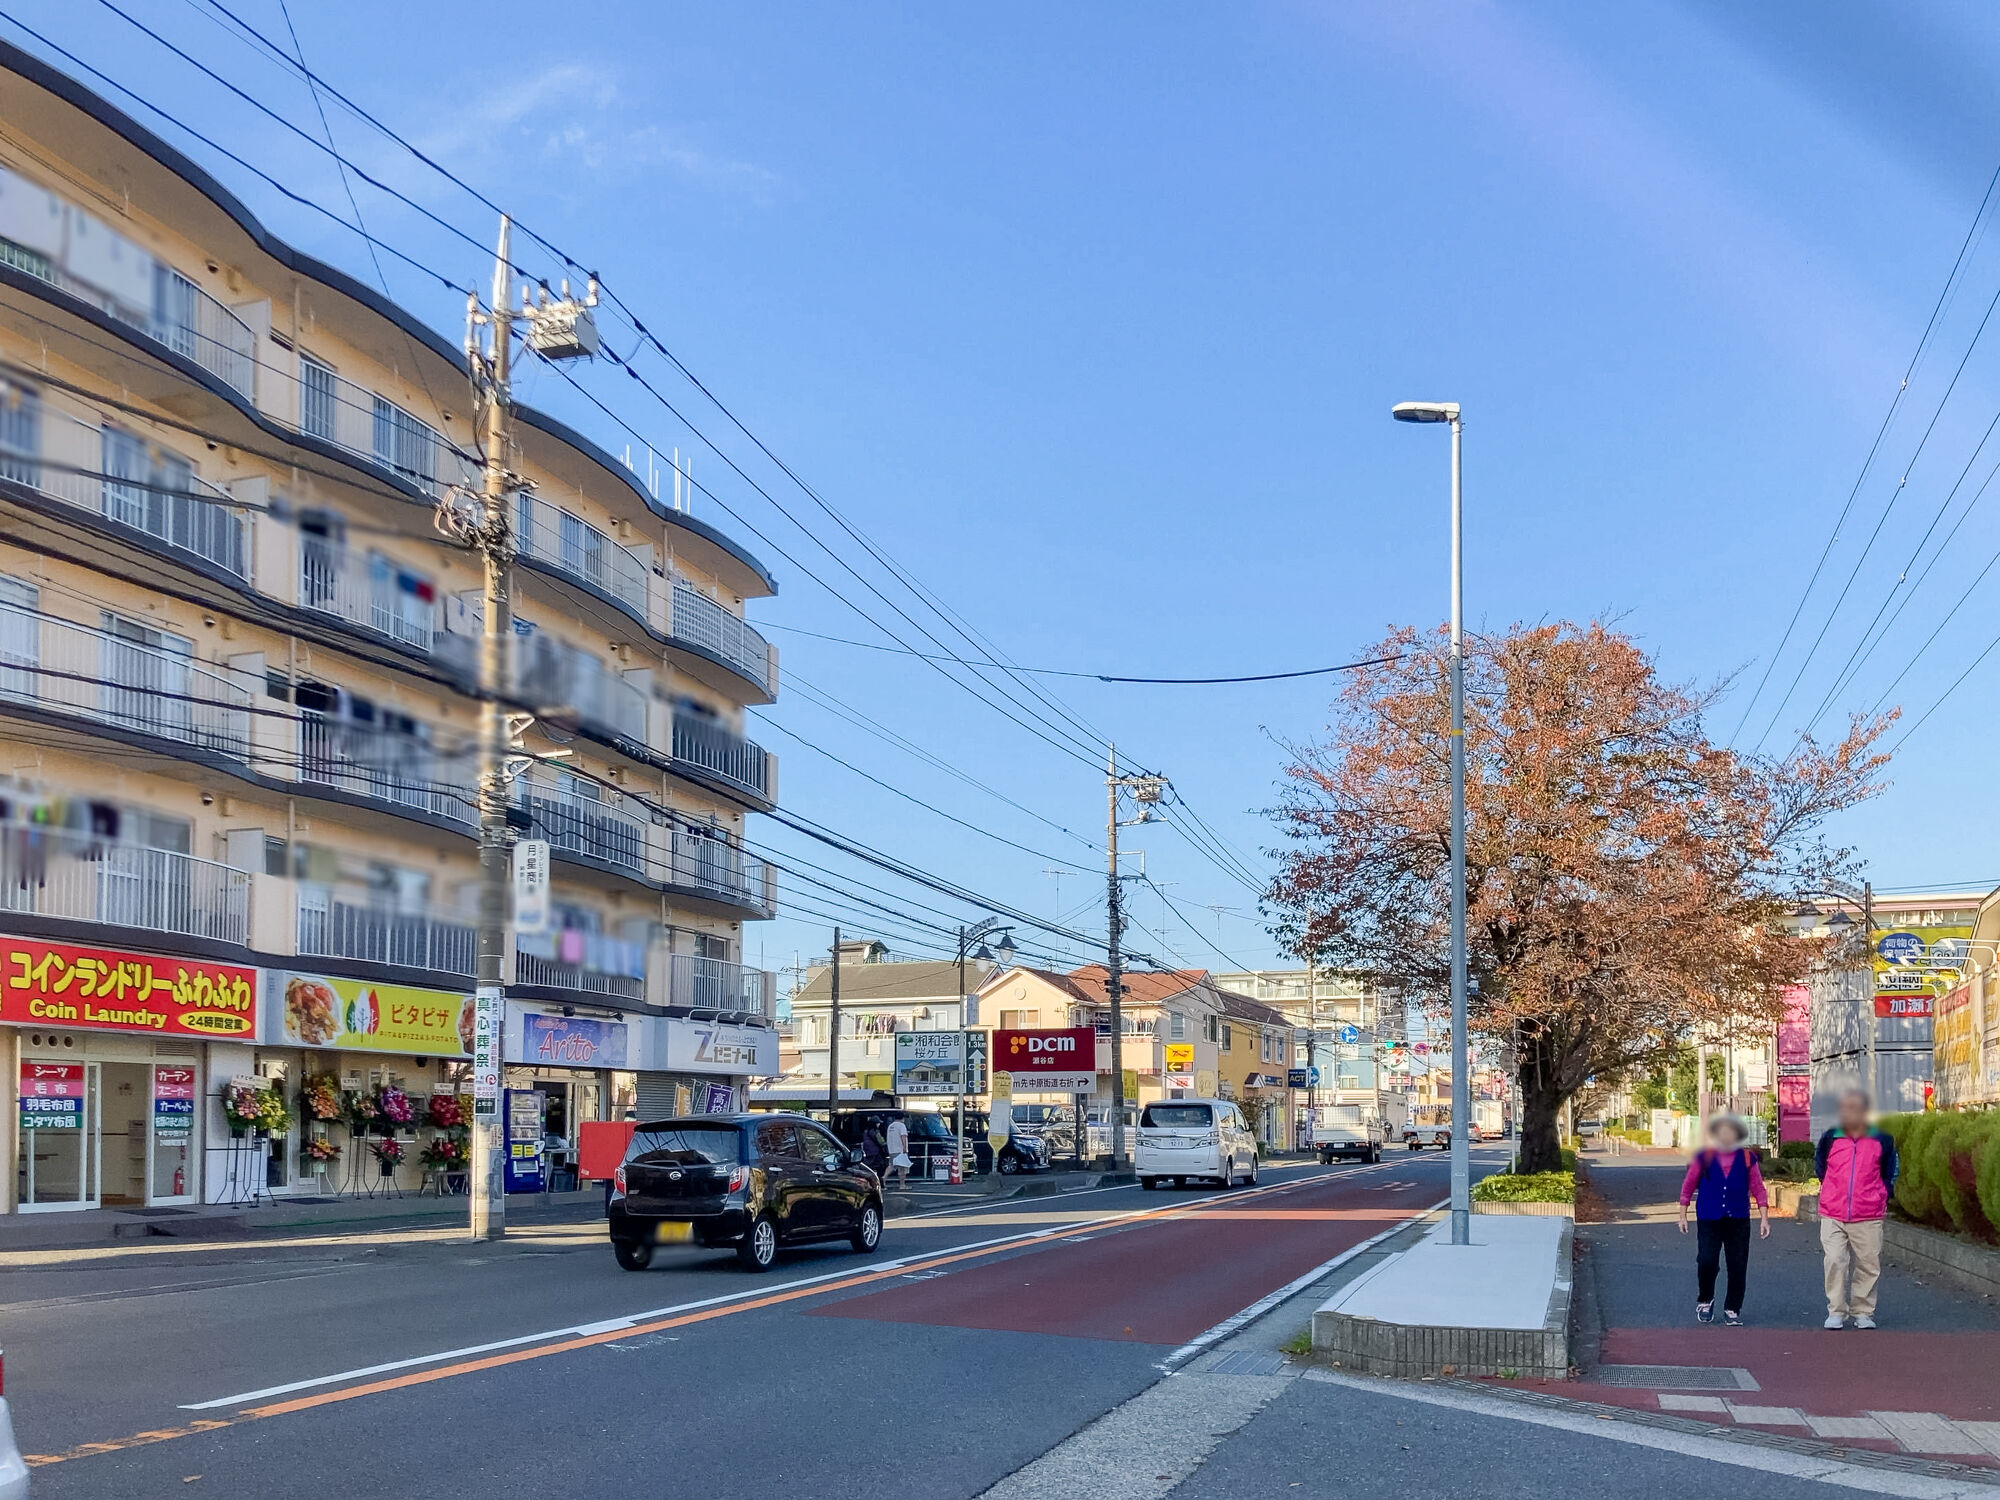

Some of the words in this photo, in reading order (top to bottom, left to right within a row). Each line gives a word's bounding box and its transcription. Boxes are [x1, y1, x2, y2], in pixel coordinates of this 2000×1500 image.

[9, 951, 251, 1012] コインランドリーふわふわ
[29, 998, 78, 1020] Coin
[84, 1003, 168, 1029] Laundry
[391, 1003, 450, 1028] ピタピザ
[187, 1015, 243, 1031] 24時間営業
[476, 997, 490, 1068] 真心葬祭
[538, 1030, 599, 1063] Arito
[713, 1046, 758, 1065] ゼミナール
[1032, 1057, 1054, 1065] 瀬谷店
[35, 1065, 68, 1078] シーツ
[158, 1071, 190, 1081] カーテン
[158, 1086, 190, 1097] スニーカー
[26, 1098, 75, 1111] 羽毛布団
[160, 1101, 192, 1112] カーペット
[24, 1115, 76, 1128] コタツ布団
